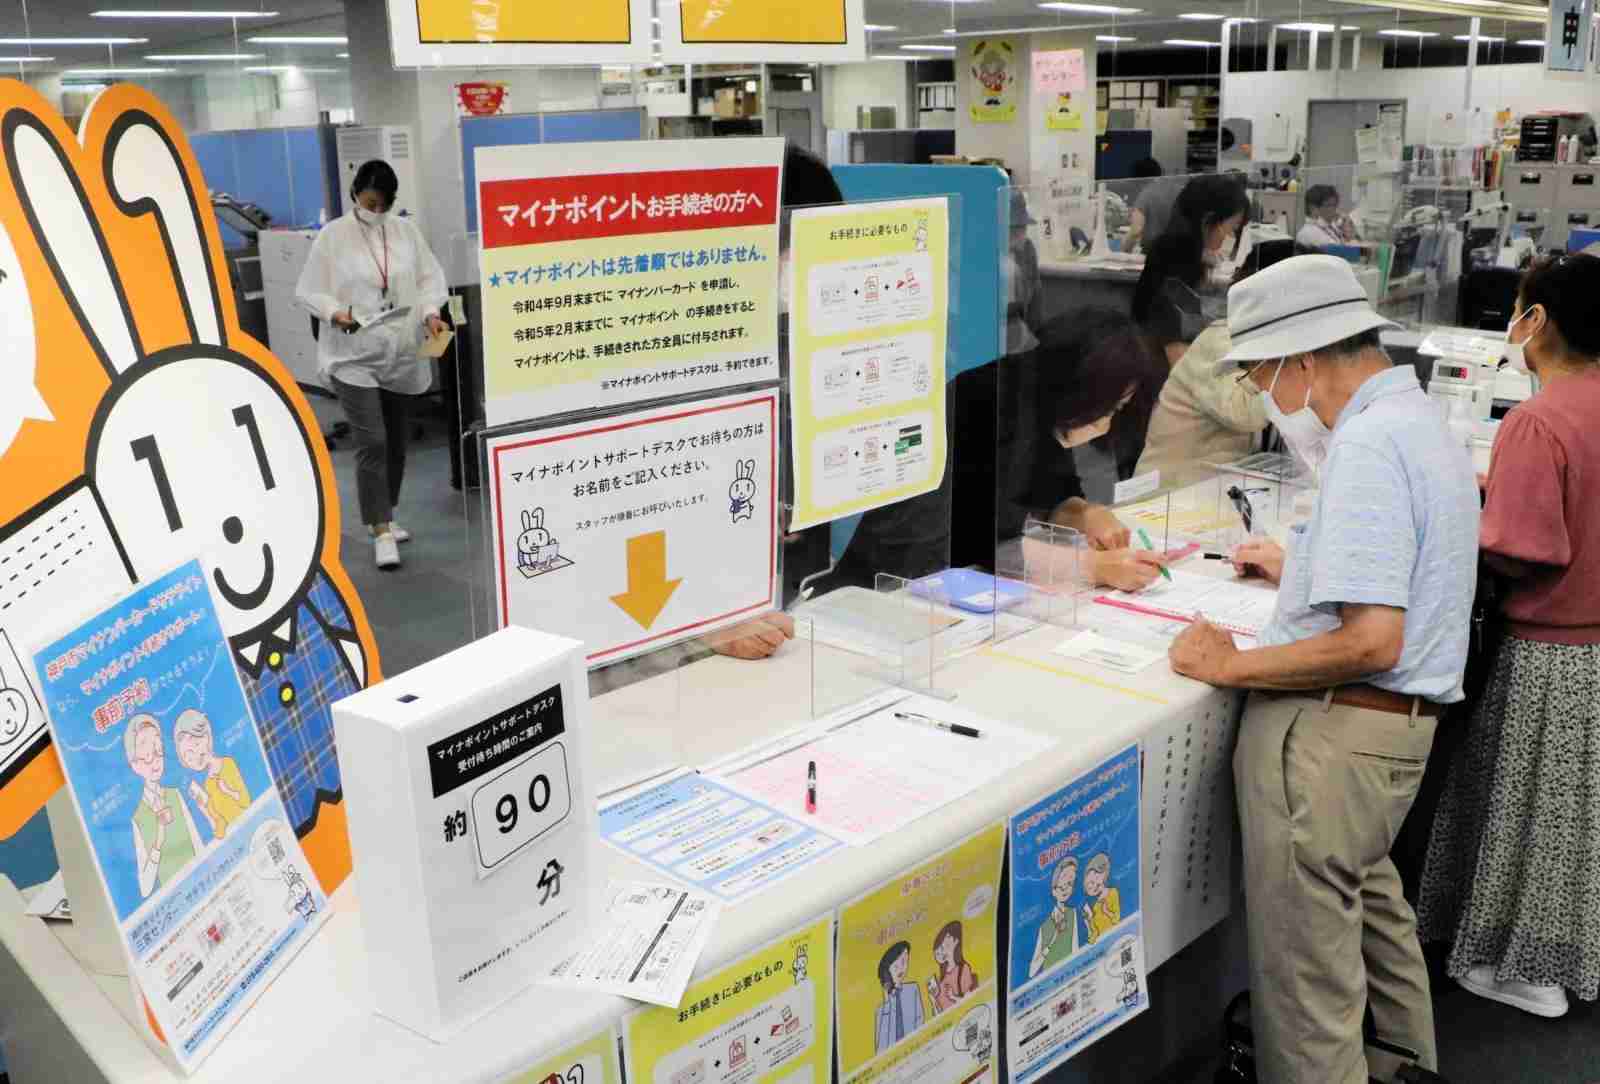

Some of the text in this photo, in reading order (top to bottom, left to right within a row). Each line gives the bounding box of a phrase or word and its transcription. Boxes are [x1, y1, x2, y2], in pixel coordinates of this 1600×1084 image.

[497, 190, 764, 228] マイナポイントお手続きの方へ
[830, 223, 908, 241] お手続きに必要なもの
[503, 244, 768, 286] マイナポイントは先着順ではありません。
[512, 289, 613, 315] 令和4年9月末までに
[618, 282, 696, 300] マイナンバーカード
[513, 300, 756, 343] 令和5年2月末までに マイナポイント の手続きをすると
[514, 327, 749, 369] マイナポイントは、手続きされた方全員に付与されます。
[511, 422, 764, 484] マイナポイントサポートデスクでお待ちの方は
[572, 459, 710, 498] お名前をご記入ください。
[437, 696, 555, 760] マイナポイントサポートデスク
[443, 810, 467, 842] 約
[495, 774, 551, 834] 90
[536, 858, 565, 906] 分
[677, 960, 784, 1023] お手続きに必要なもの
